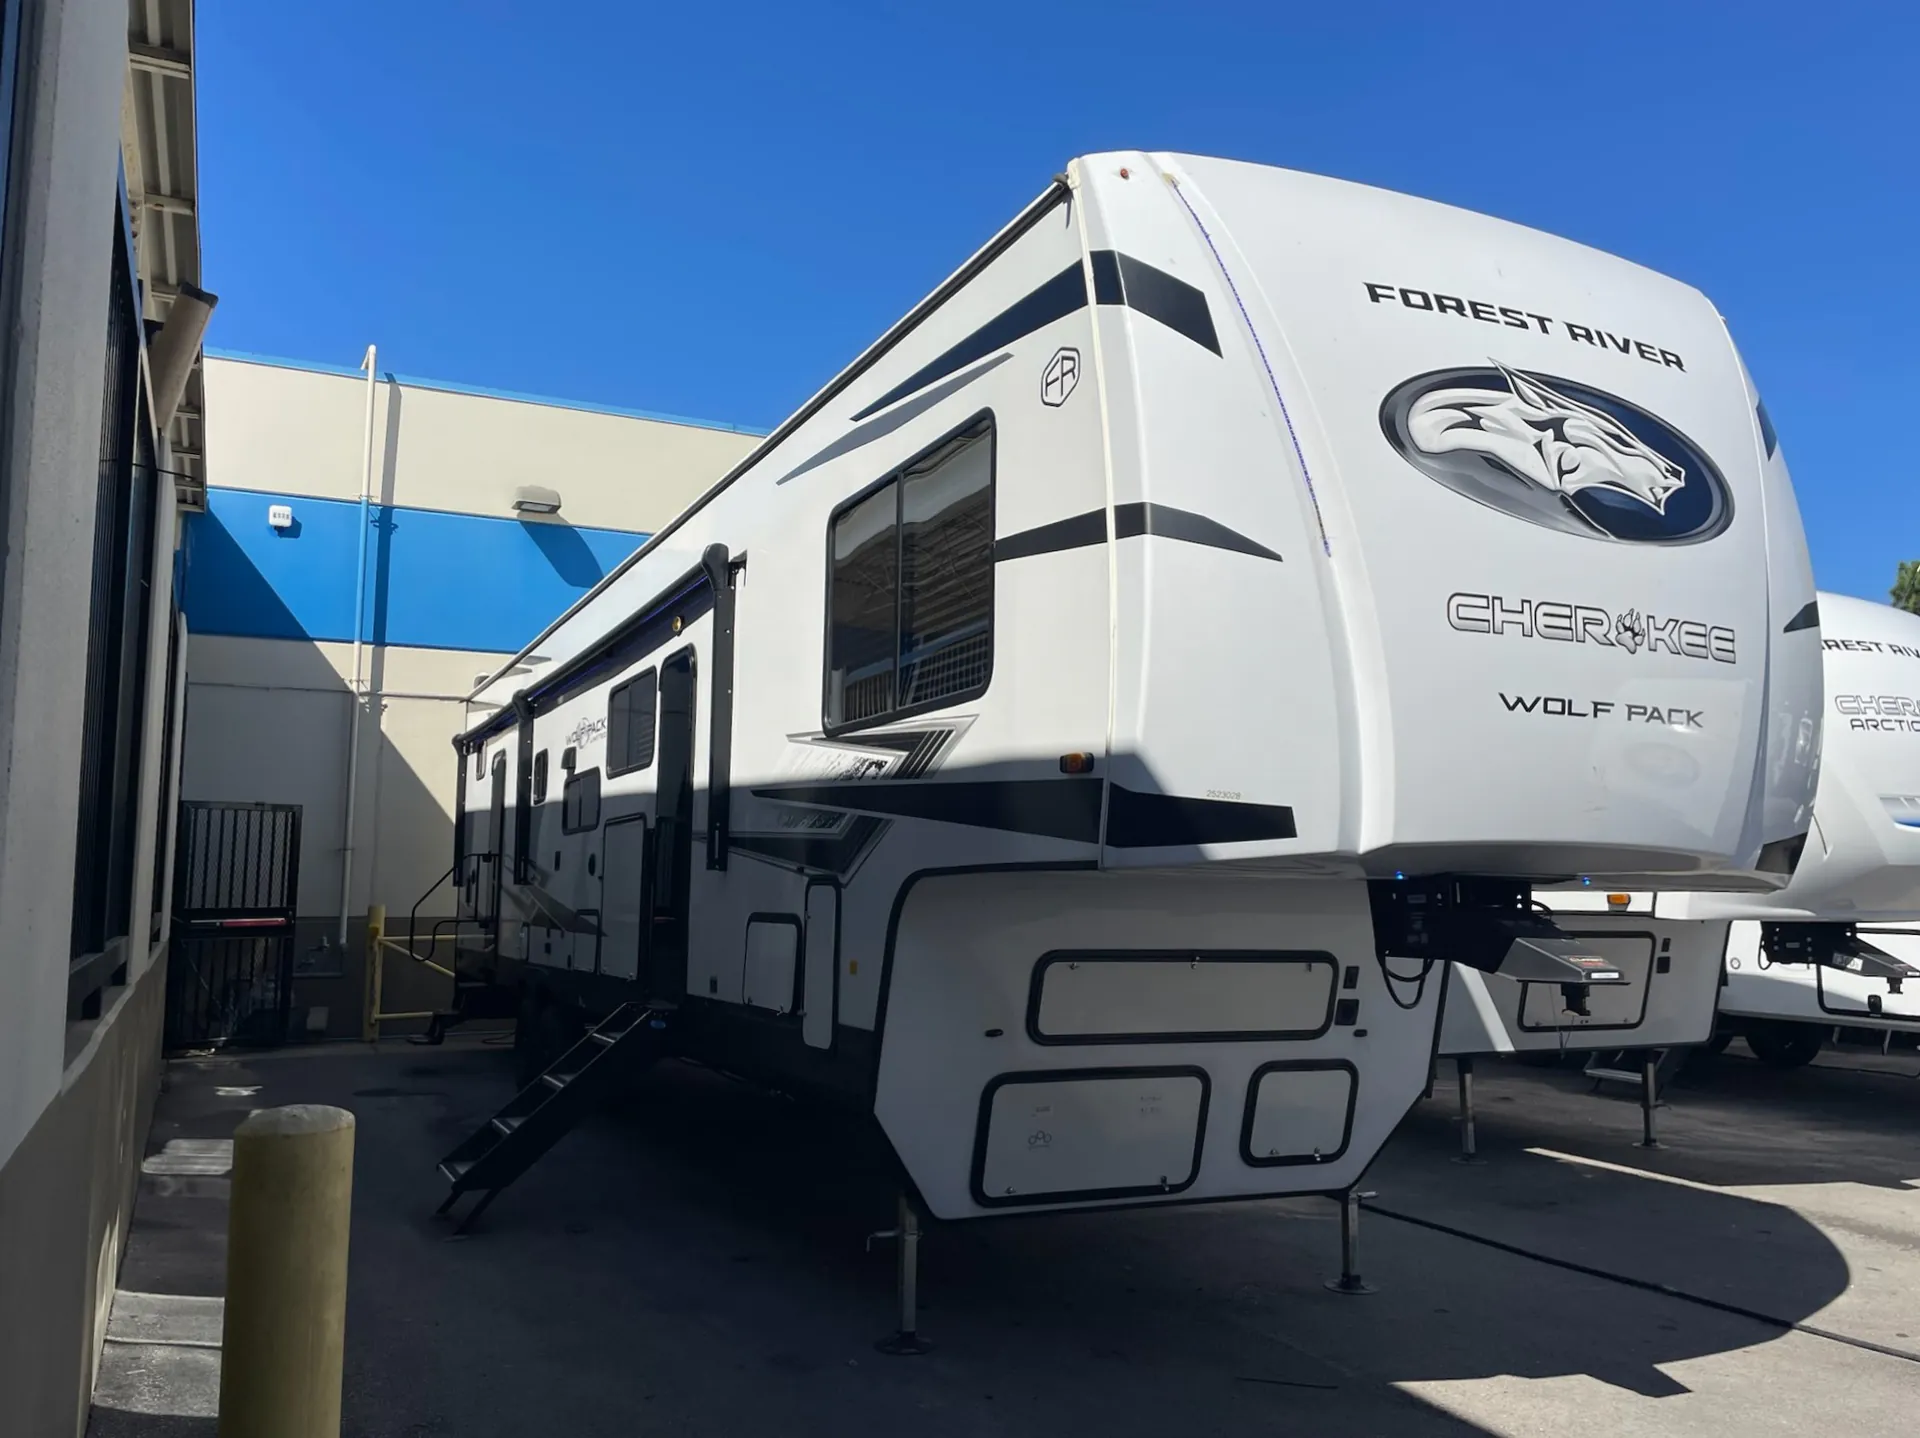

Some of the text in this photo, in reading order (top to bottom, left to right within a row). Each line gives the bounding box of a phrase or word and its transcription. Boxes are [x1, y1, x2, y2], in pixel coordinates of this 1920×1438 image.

[1363, 282, 1688, 373] FOREST RIVER
[1821, 639, 1884, 653] REST
[1498, 692, 1704, 728] WOLF PACK
